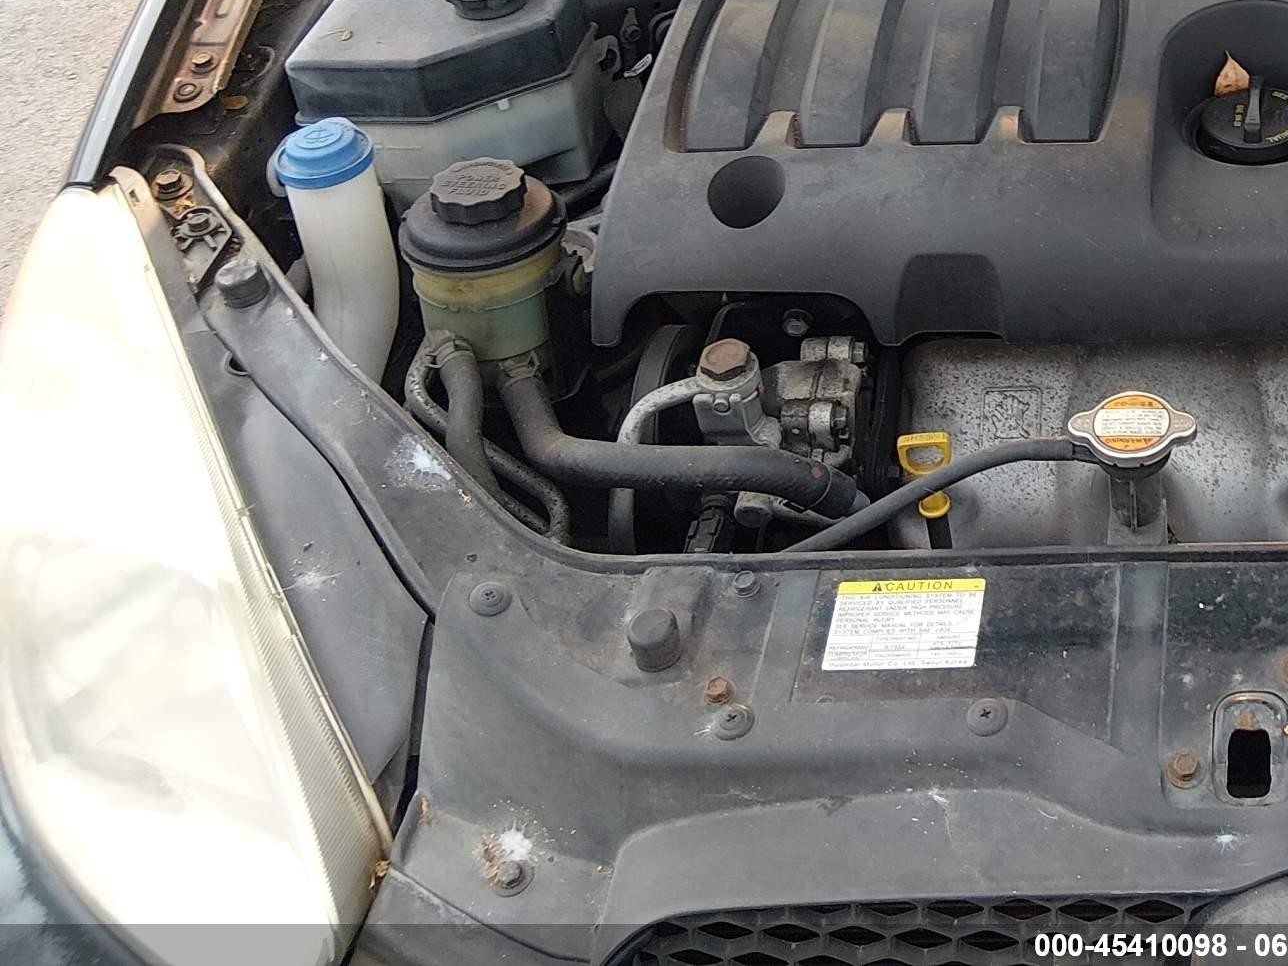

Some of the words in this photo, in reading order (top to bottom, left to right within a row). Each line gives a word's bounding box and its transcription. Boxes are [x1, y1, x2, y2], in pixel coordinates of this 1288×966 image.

[455, 174, 500, 182] POWER
[441, 180, 506, 190] STEERING
[447, 188, 490, 196] FLUID
[886, 580, 953, 592] CAUTION
